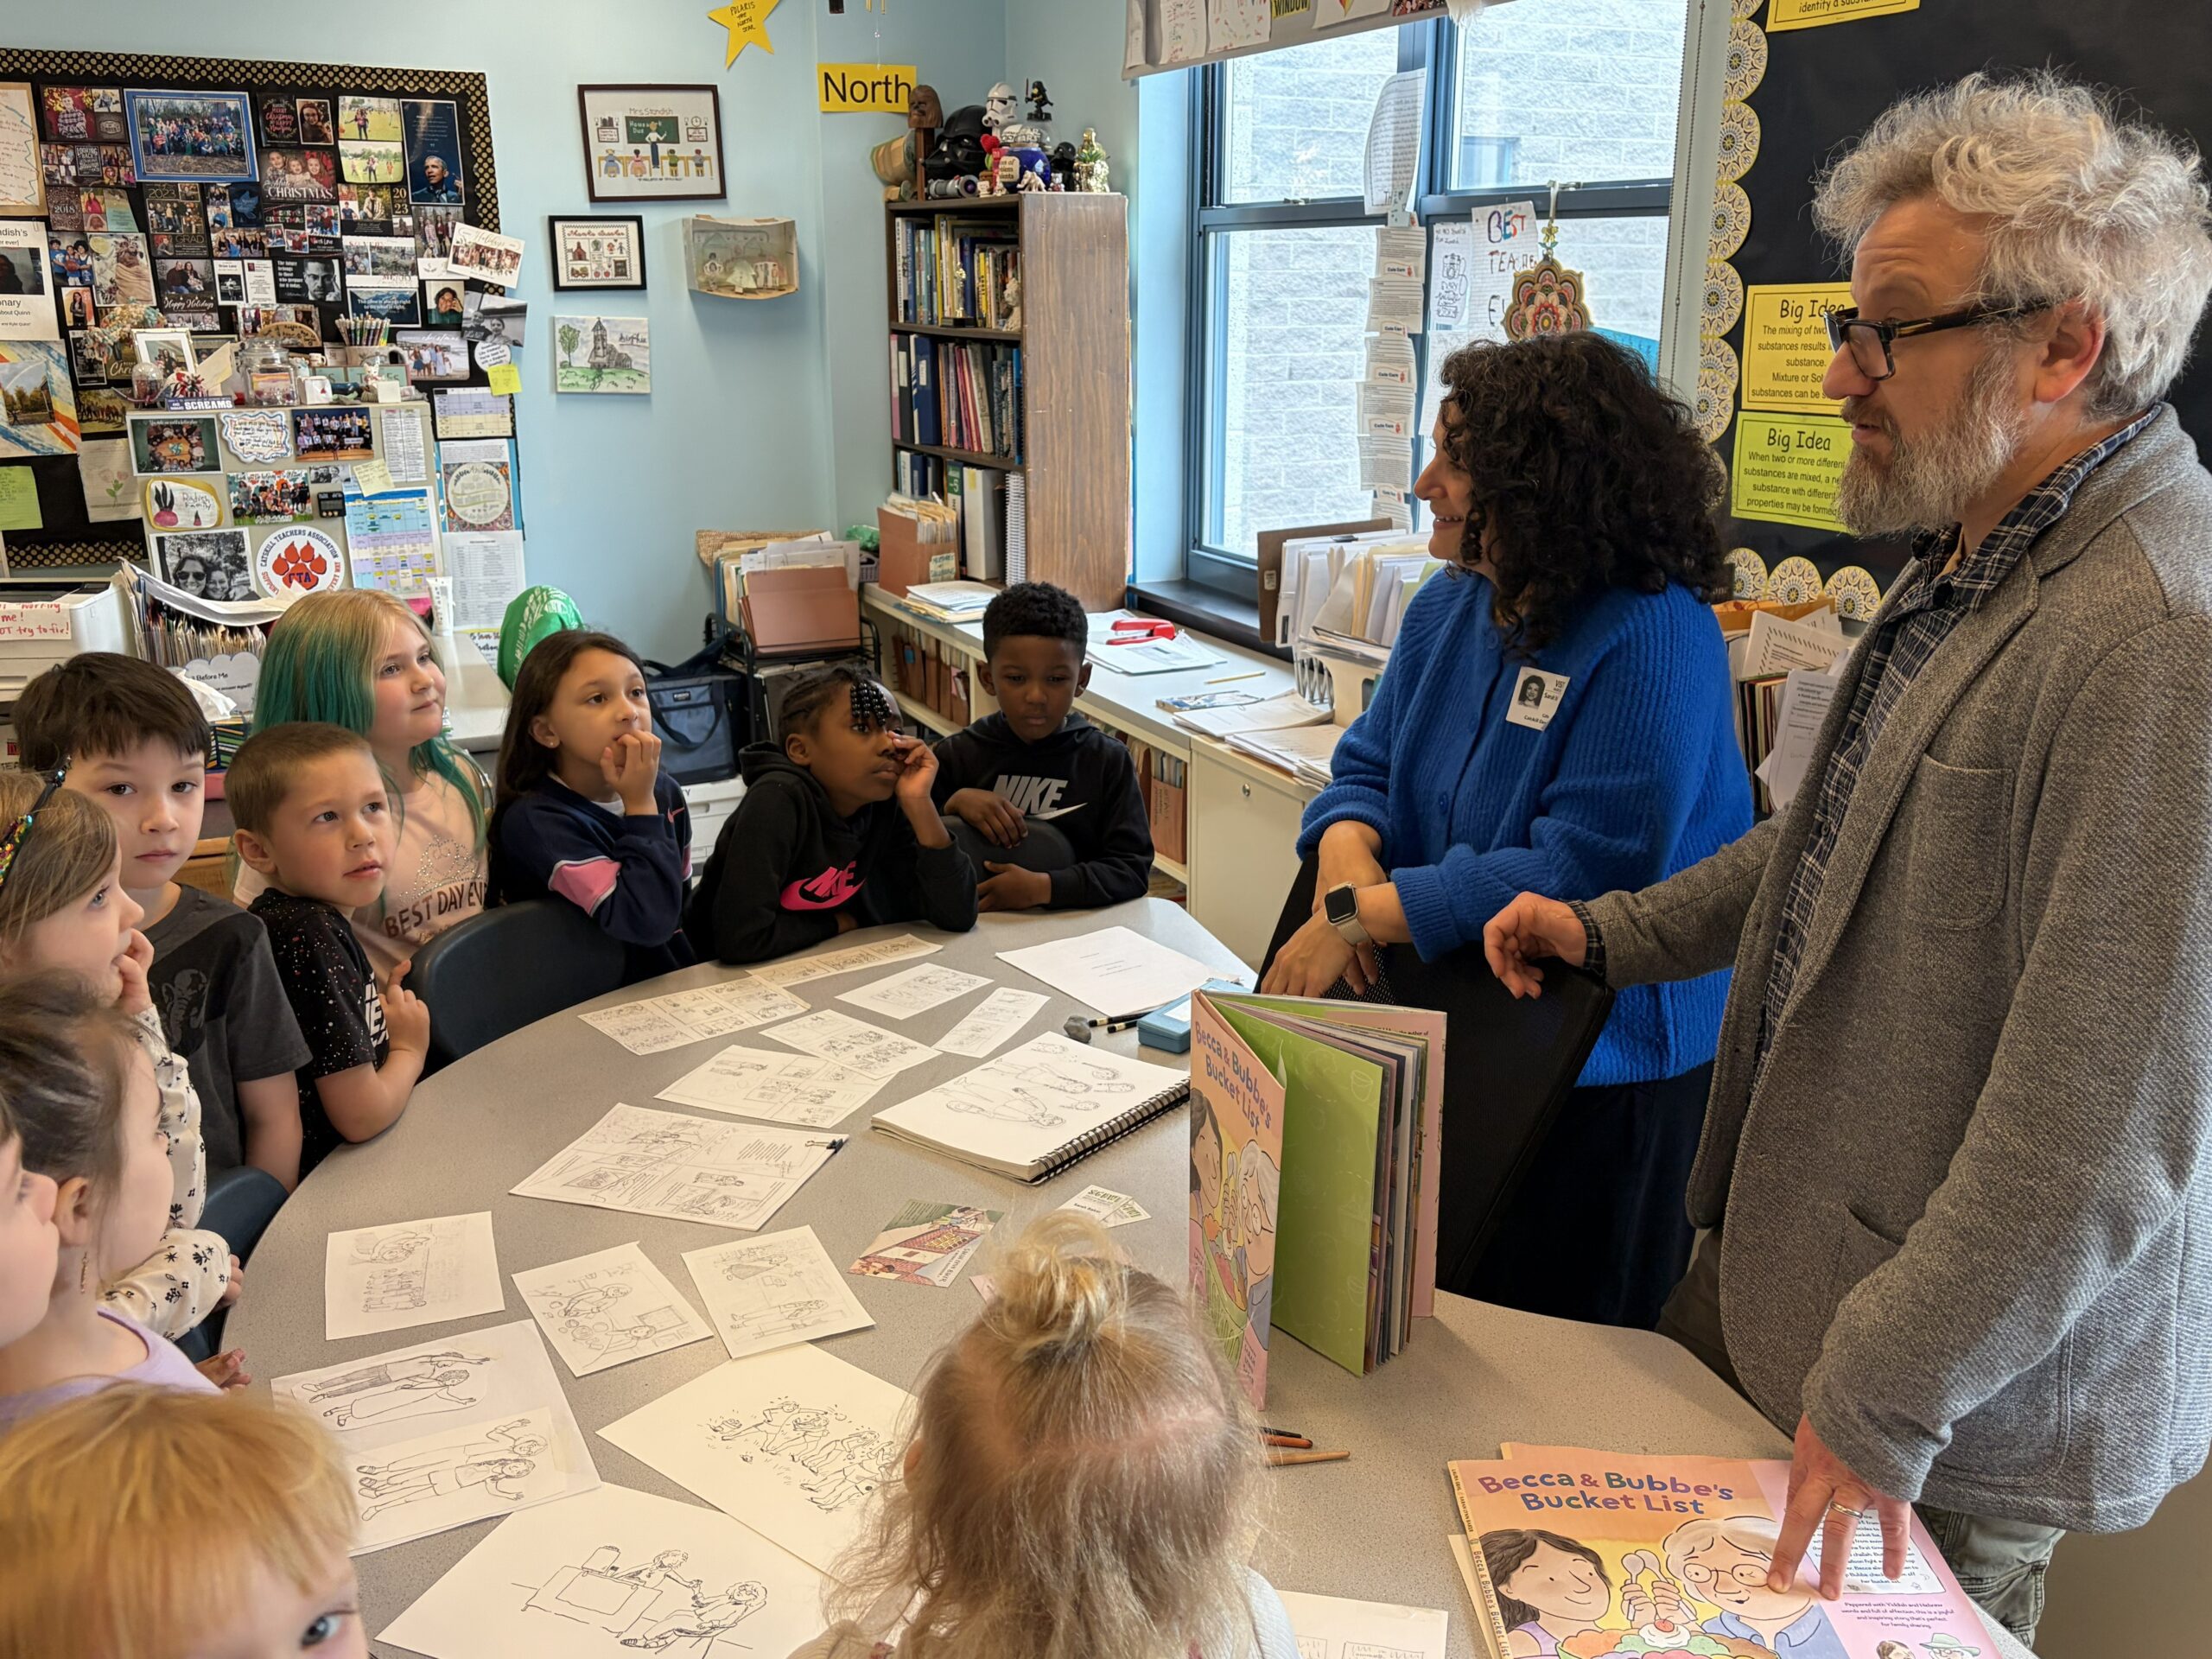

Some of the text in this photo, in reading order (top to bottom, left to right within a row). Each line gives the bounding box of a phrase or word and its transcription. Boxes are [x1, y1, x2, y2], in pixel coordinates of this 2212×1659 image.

[729, 1, 756, 16] POLARIS
[737, 16, 753, 28] NORTH
[823, 73, 912, 103] North
[149, 188, 176, 199] 2023
[392, 188, 407, 199] 20
[54, 204, 75, 213] 2018
[394, 203, 409, 214] 23
[1487, 210, 1526, 243] BEST
[175, 234, 205, 244] GRAD
[163, 298, 214, 311] Happy Holidays
[1780, 299, 1804, 324] Big
[1763, 325, 1777, 335] The
[1778, 326, 1802, 338] mixing
[1803, 325, 1813, 335] of
[1758, 341, 1826, 352] substances results
[1785, 358, 1827, 368] substance.
[1772, 372, 1799, 383] Mixture
[1751, 388, 1793, 398] substances
[1794, 390, 1808, 398] can
[1809, 389, 1821, 399] be
[184, 400, 232, 410] SCREAMS
[1767, 429, 1831, 453] Big Idea
[1748, 451, 1770, 462] When
[1771, 454, 1786, 464] two
[1796, 457, 1815, 467] more
[1744, 466, 1786, 479] substances
[1787, 472, 1798, 481] are
[1752, 482, 1790, 495] substance
[1791, 486, 1806, 496] with
[1746, 496, 1784, 510] properties
[1785, 499, 1801, 512] may
[1802, 500, 1811, 512] be
[260, 530, 339, 567] CATSKILL TEACHERS ASSOCIATION
[16, 626, 35, 637] try
[36, 625, 48, 633] to
[992, 774, 1070, 814] NIKE
[385, 894, 433, 938] BEST
[437, 883, 465, 915] DAY
[1195, 1021, 1272, 1129] Becca & Bubbe's
[1205, 1053, 1261, 1136] Bucket List
[1478, 1471, 1734, 1501] Becca & Bubbe's
[1520, 1490, 1705, 1515] Bucket List
[1473, 1551, 1485, 1572] Becca
[1482, 1580, 1497, 1609] Bubbe's
[1491, 1611, 1505, 1638] Bucket
[1499, 1641, 1511, 1657] List
